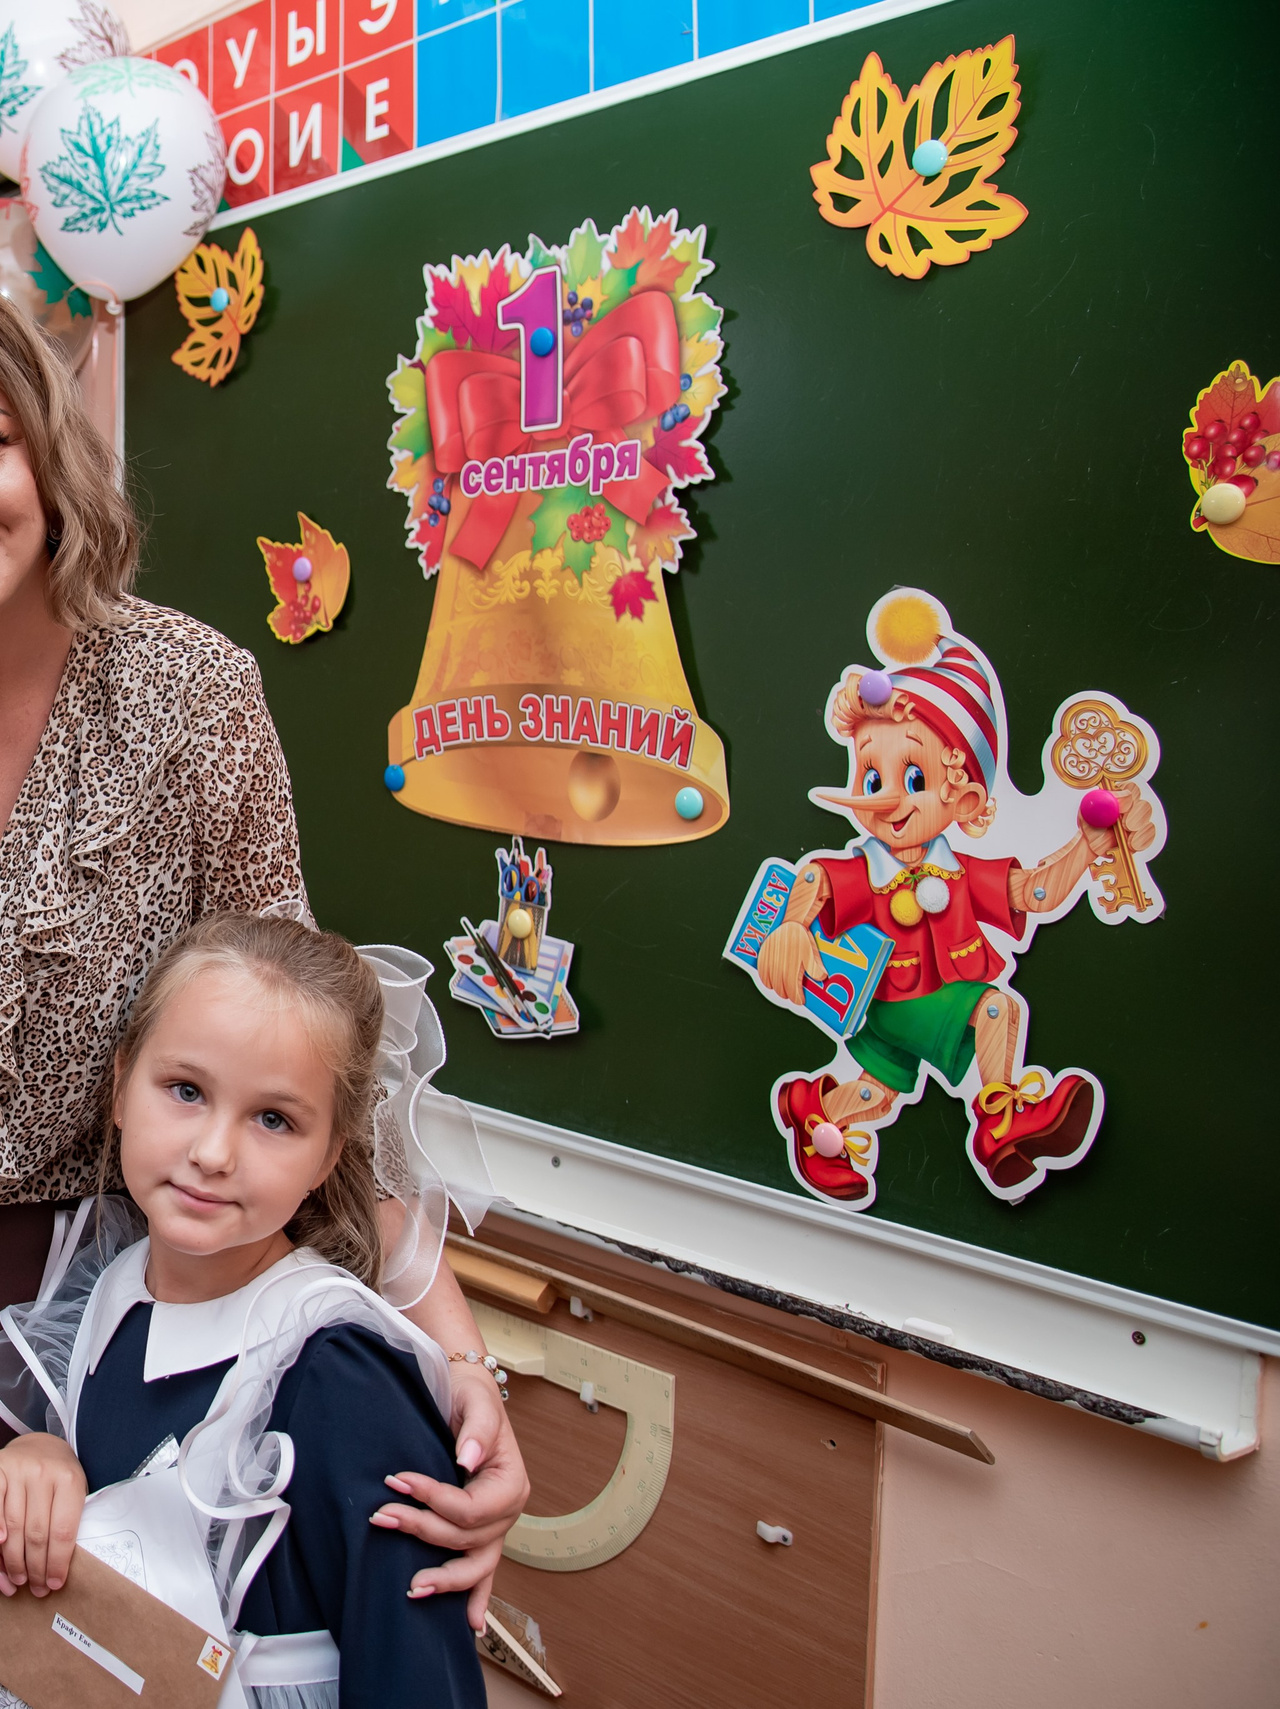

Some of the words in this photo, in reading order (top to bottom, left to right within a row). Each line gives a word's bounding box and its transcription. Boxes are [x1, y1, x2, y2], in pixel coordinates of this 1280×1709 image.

[289, 102, 322, 169] И
[498, 266, 562, 432] 1
[461, 434, 640, 496] сентября
[413, 694, 512, 760] ДЕНЬ
[519, 693, 696, 770] ЗНАНИЙ
[735, 871, 790, 958] АЗБУКА
[56, 1617, 77, 1636] Крафт
[78, 1633, 92, 1648] Еве
